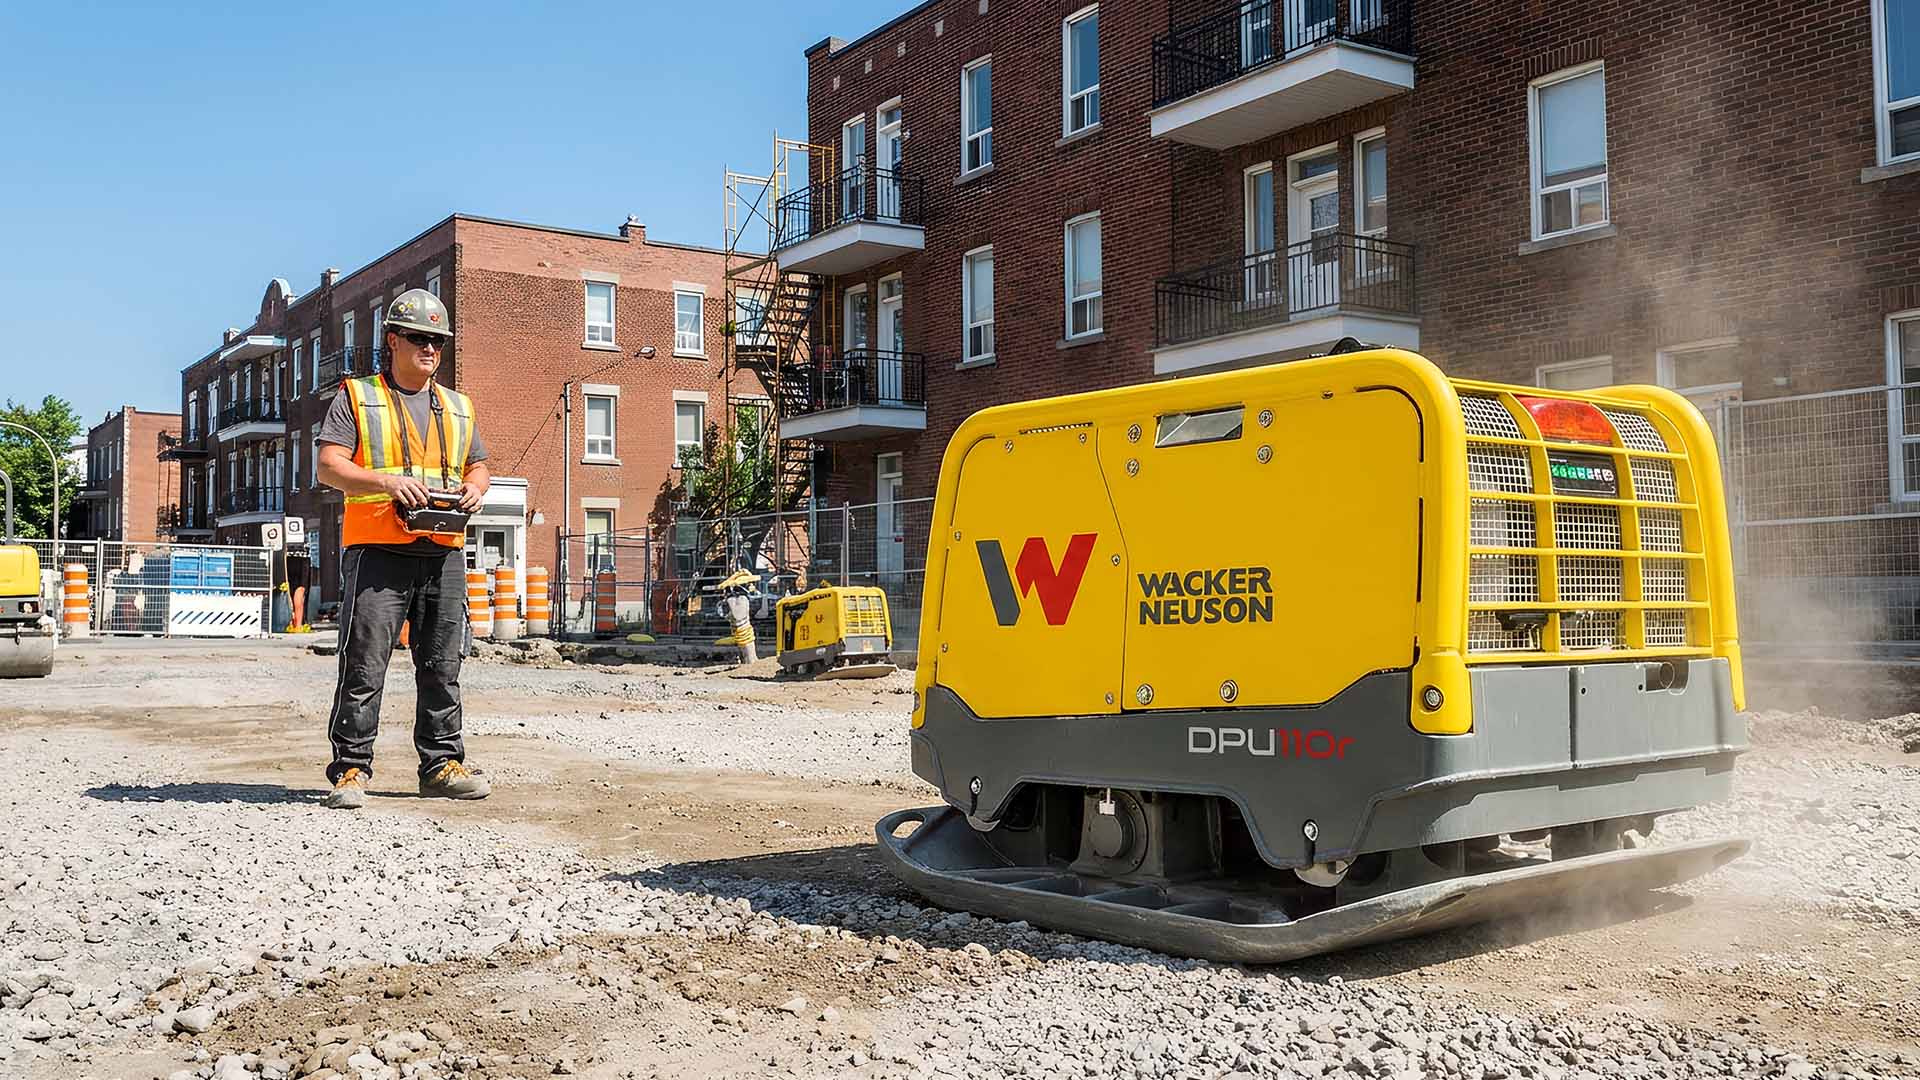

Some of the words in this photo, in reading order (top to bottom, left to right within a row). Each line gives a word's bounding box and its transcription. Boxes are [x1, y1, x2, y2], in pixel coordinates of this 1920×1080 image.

[1137, 566, 1273, 598] WACKER
[1139, 596, 1273, 625] NEUSON
[1188, 726, 1357, 760] DPU110r
